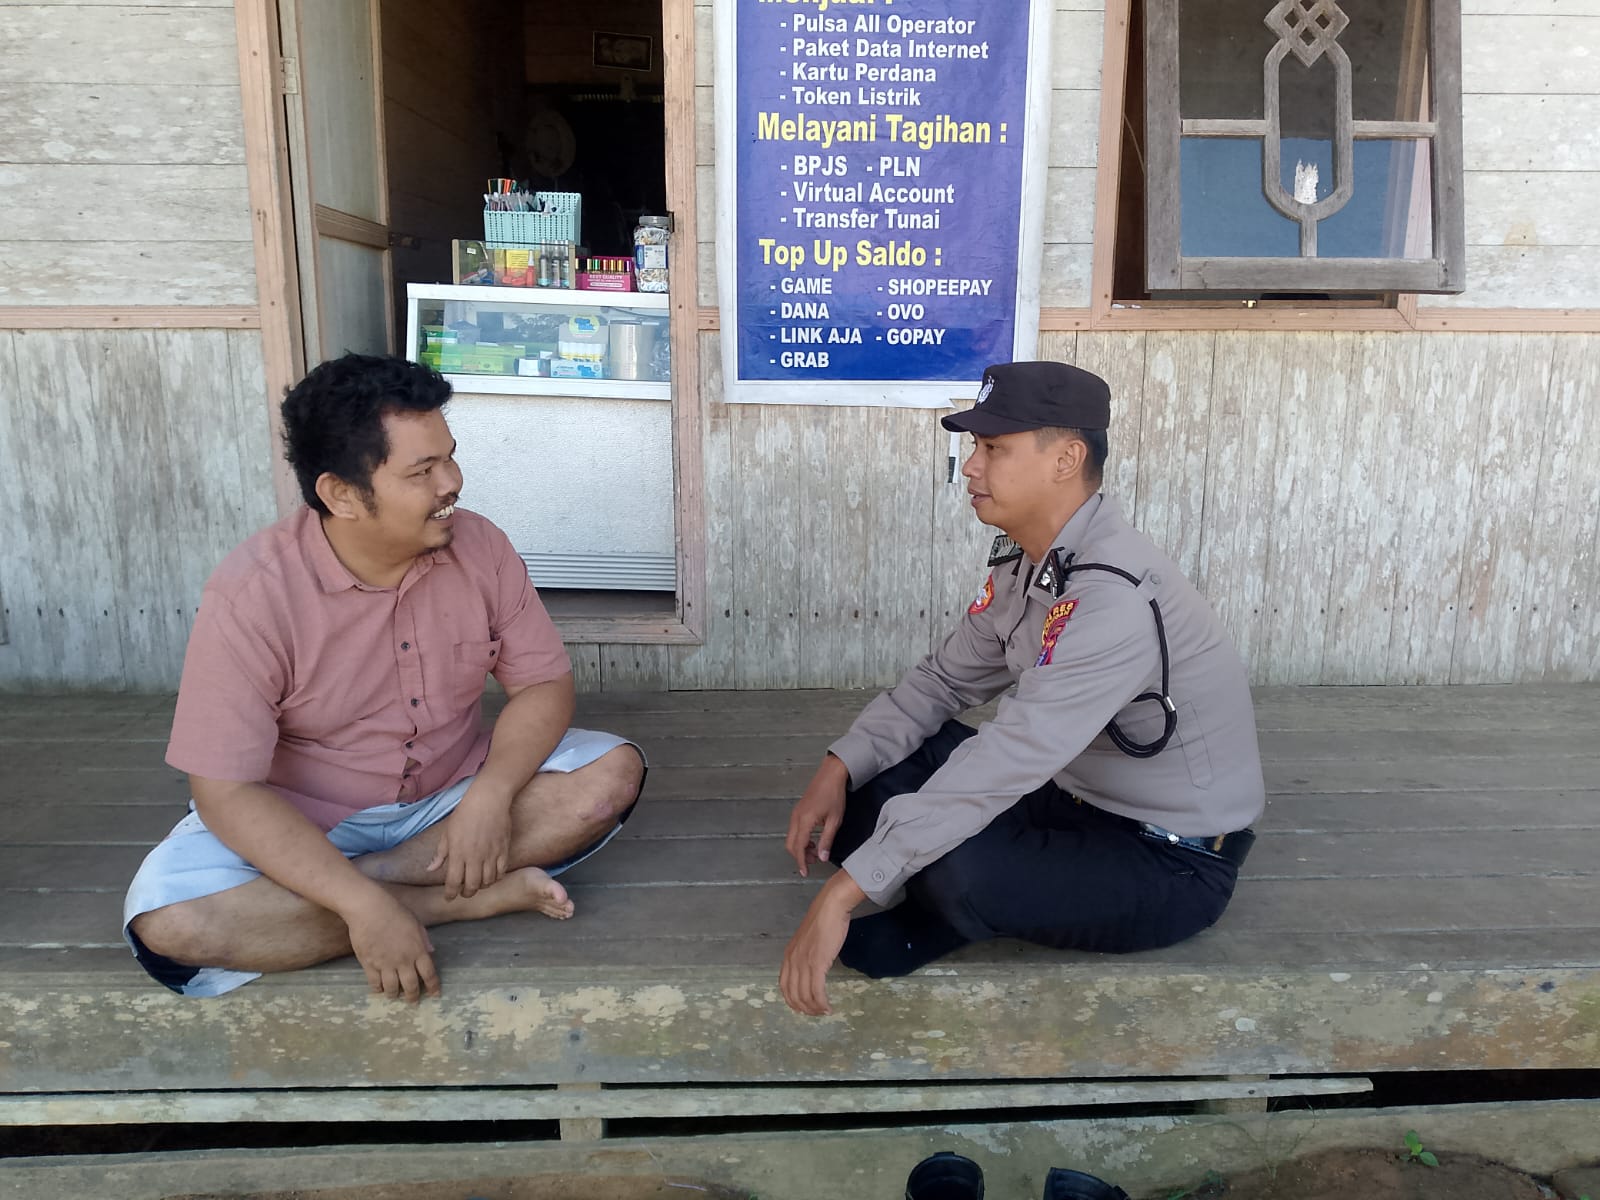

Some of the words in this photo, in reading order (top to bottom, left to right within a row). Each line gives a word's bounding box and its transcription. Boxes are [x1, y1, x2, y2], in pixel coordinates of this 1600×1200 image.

[793, 13, 848, 33] Pulsa
[853, 14, 880, 33] All
[886, 14, 976, 38] Operator
[793, 37, 850, 57] Paket
[856, 38, 902, 58] Data
[908, 39, 989, 59] Internet
[792, 62, 849, 81] Kartu
[855, 62, 937, 83] Perdana
[791, 86, 851, 105] Token
[858, 87, 921, 106] Listrik
[758, 111, 877, 149] Melayani
[885, 113, 991, 150] Tagihan
[794, 154, 848, 177] BPJS
[879, 156, 921, 177] PLN
[793, 181, 863, 203] Virtual
[868, 182, 955, 204] Account
[792, 207, 879, 229] Transfer
[884, 208, 940, 230] Tunai
[758, 238, 805, 272] Top
[814, 239, 848, 272] Up
[855, 239, 927, 267] Saldo
[781, 277, 833, 295] GAME
[887, 278, 993, 296] SHOPEEPAY
[781, 302, 830, 319] DANA
[887, 303, 925, 320] OVO
[781, 327, 823, 344] LINK
[828, 328, 862, 344] AJA
[887, 328, 946, 345] GOPAY
[780, 351, 829, 368] GRAB
